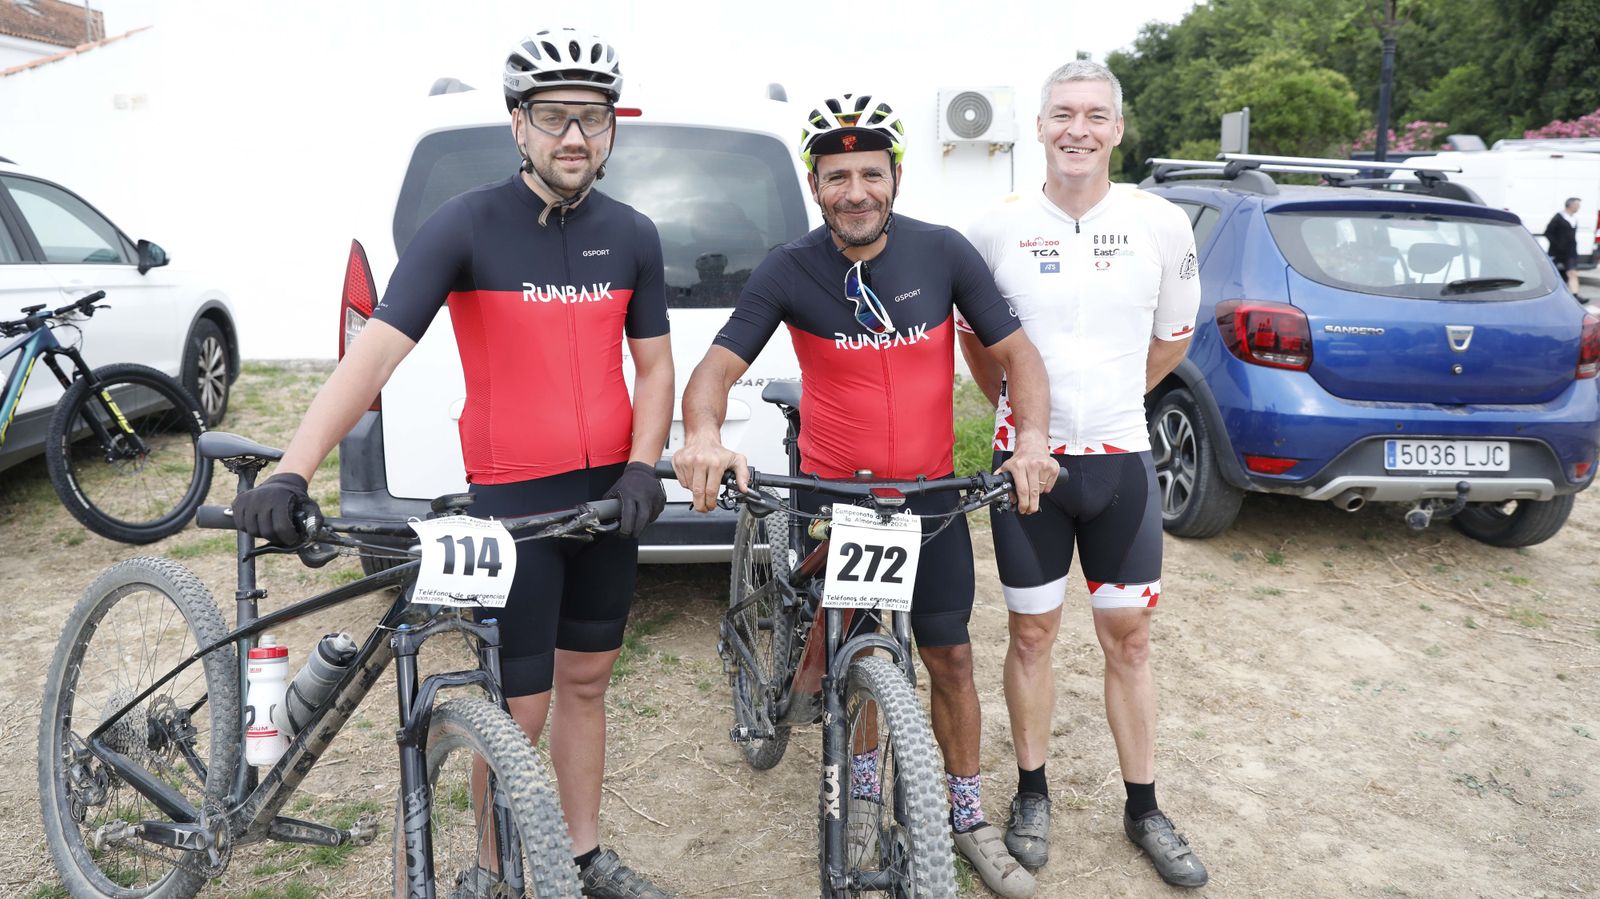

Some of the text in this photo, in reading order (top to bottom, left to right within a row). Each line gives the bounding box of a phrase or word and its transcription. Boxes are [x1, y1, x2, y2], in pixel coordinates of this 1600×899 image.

[1093, 234, 1128, 245] GOBIK
[582, 249, 610, 257] GSPORT
[1031, 249, 1060, 257] TCA
[522, 282, 613, 304] RUNBAIK
[894, 288, 921, 303] GSPORT
[834, 322, 930, 351] RUNBAIK
[1324, 325, 1385, 336] SANDERO
[1401, 444, 1504, 467] 5036 LJC
[436, 534, 502, 577] 114
[837, 542, 907, 584] 272
[418, 588, 452, 597] Teléfonos
[455, 591, 464, 599] de
[826, 594, 858, 602] Teléfonos
[869, 596, 909, 605] emergencias
[824, 764, 841, 820] FOX
[405, 829, 427, 899] FOX
